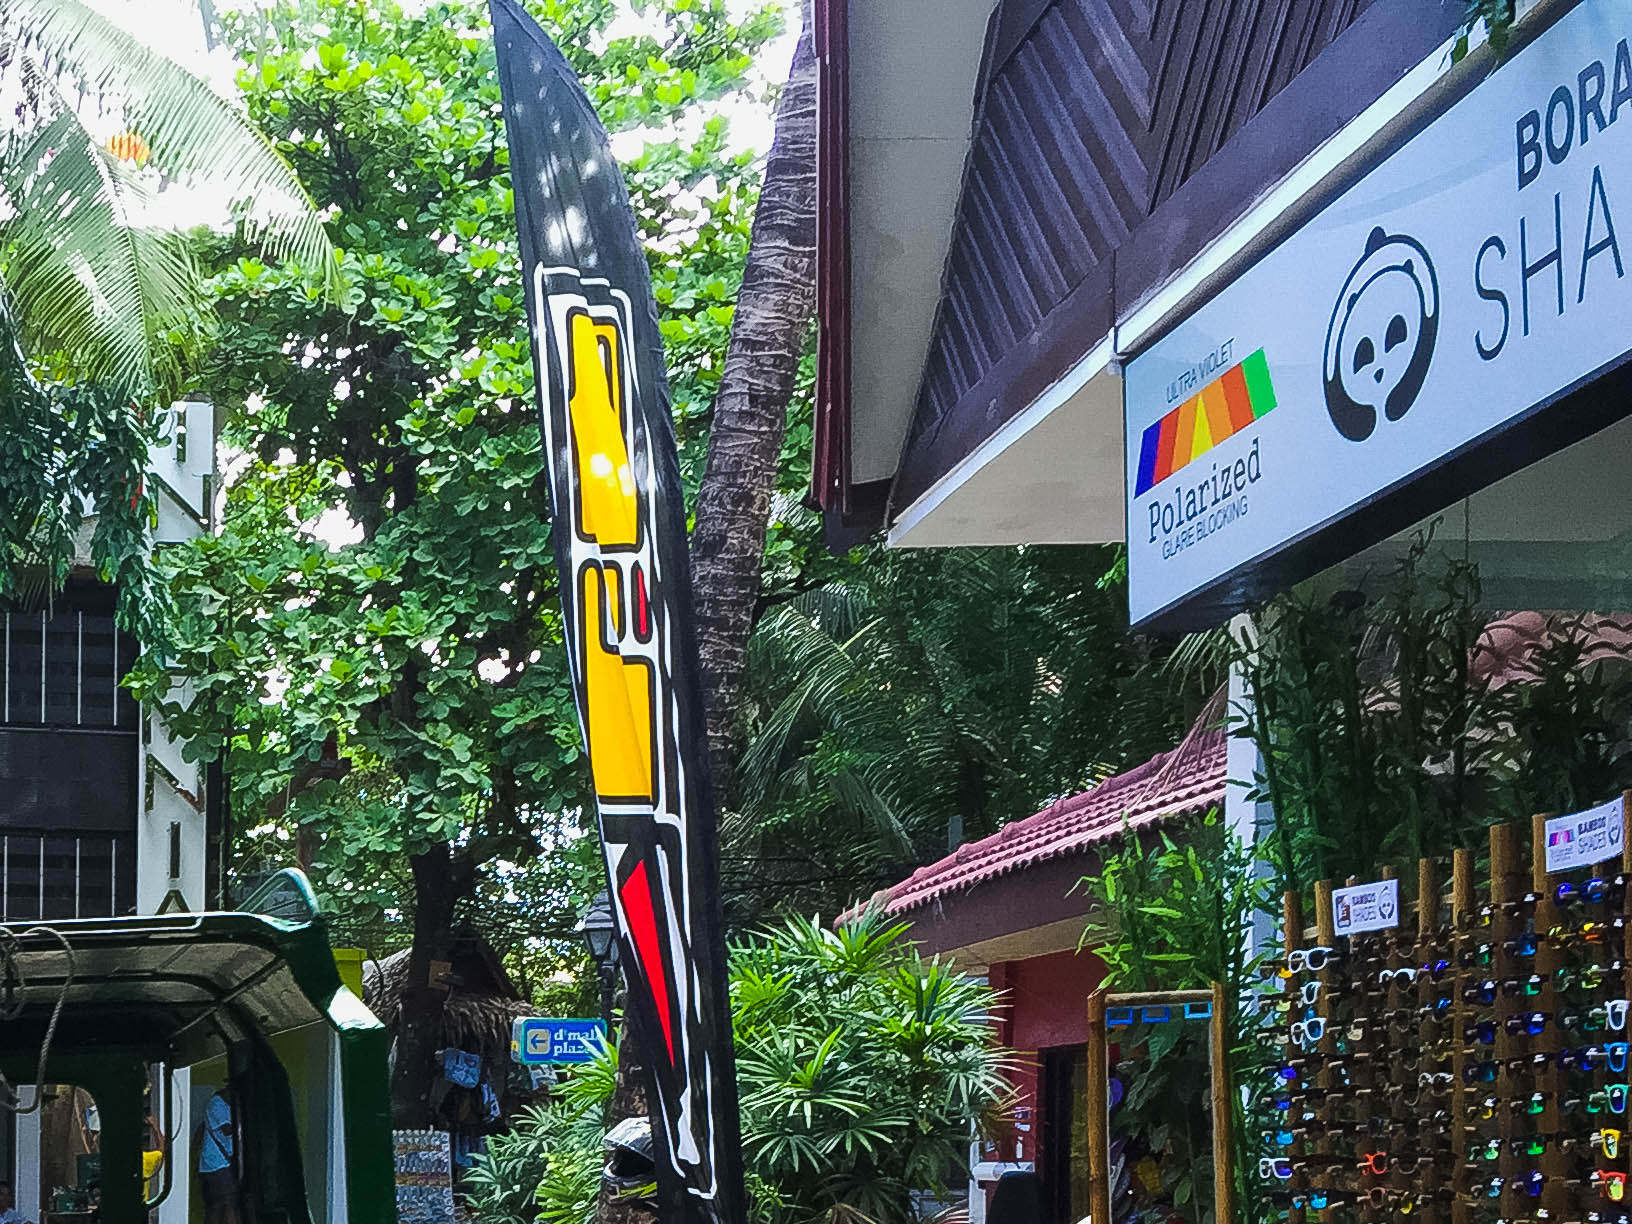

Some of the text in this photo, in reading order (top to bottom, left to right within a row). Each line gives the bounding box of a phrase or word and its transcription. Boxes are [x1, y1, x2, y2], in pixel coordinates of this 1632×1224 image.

[1516, 38, 1632, 192] BORA
[1474, 164, 1625, 362] SHA
[1166, 338, 1235, 404] ULTRA VIOLET
[1148, 436, 1262, 544] Polarized
[1161, 495, 1249, 560] GLARE BLOCKING
[553, 1042, 590, 1057] plaz
[554, 1028, 599, 1041] d'mal
